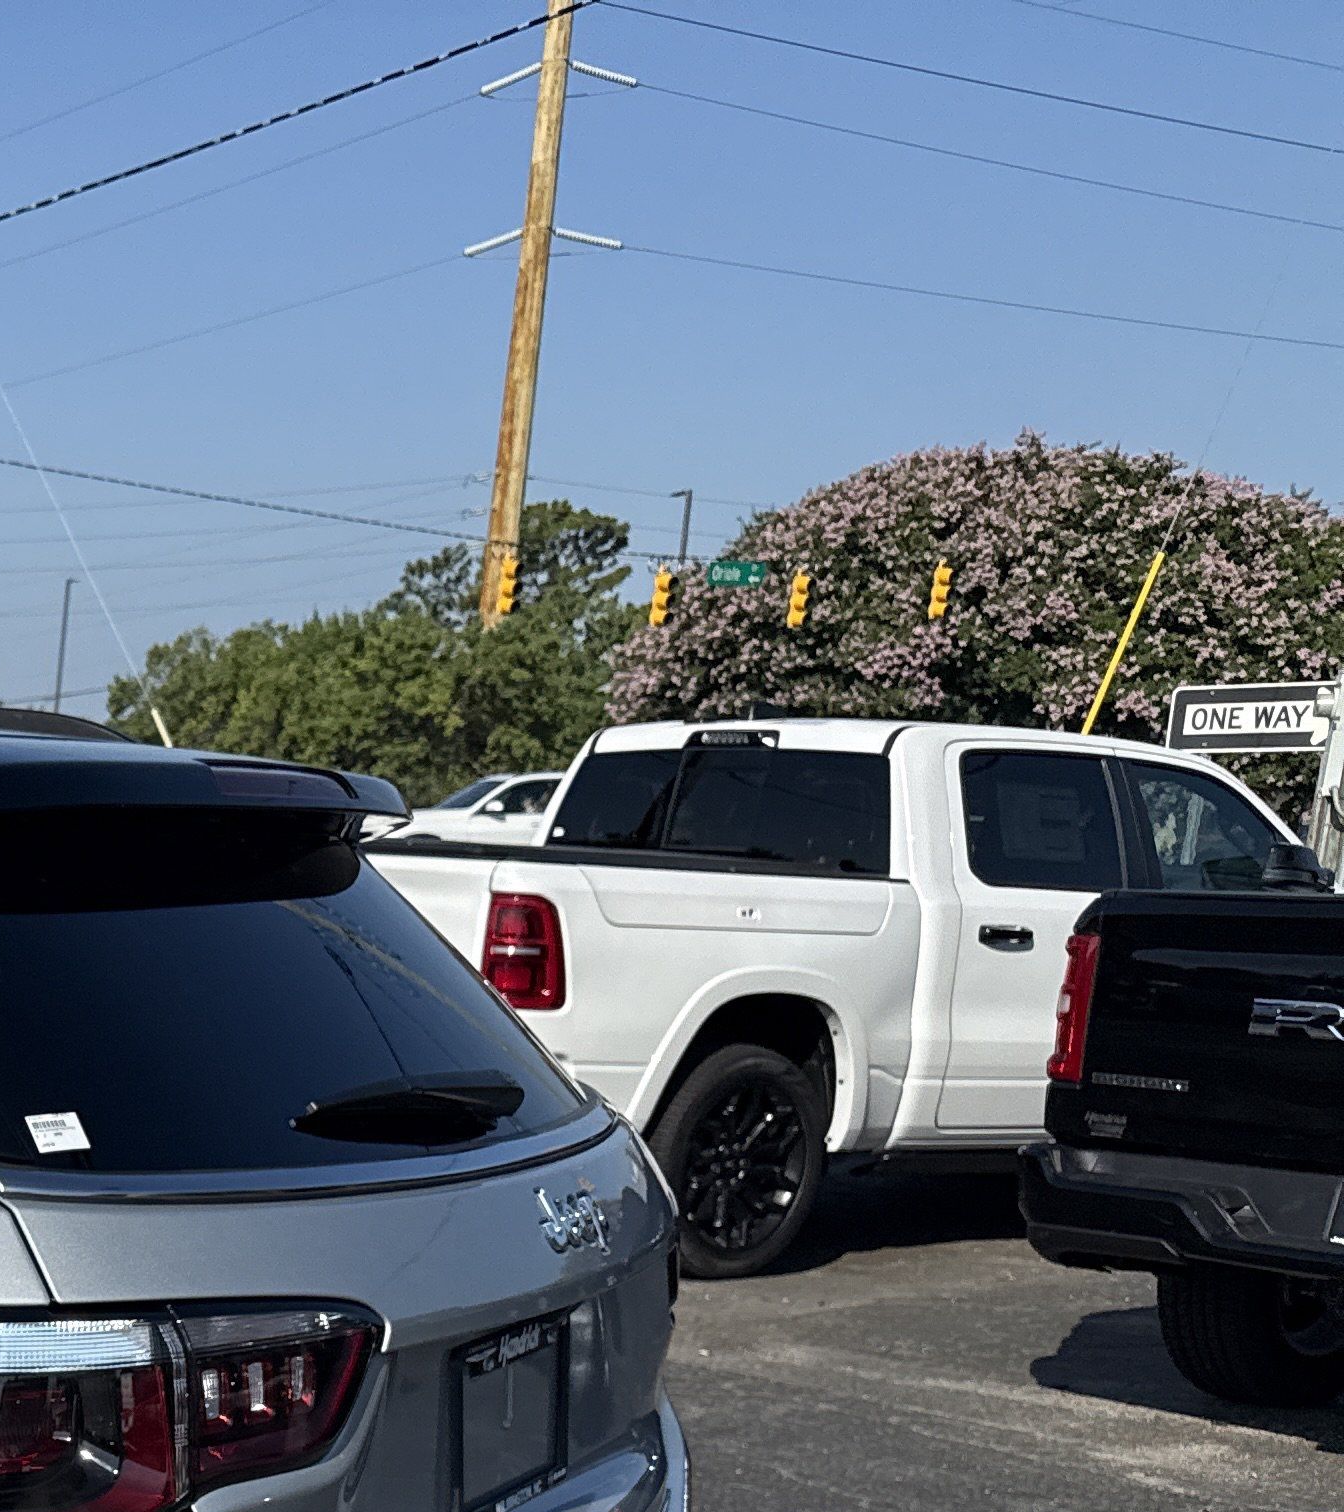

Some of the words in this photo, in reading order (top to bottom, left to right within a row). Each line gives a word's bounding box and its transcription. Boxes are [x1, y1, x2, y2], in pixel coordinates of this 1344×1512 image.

[1191, 706, 1244, 730] ONE
[1255, 704, 1310, 729] WAY
[533, 1186, 610, 1255] Jeep
